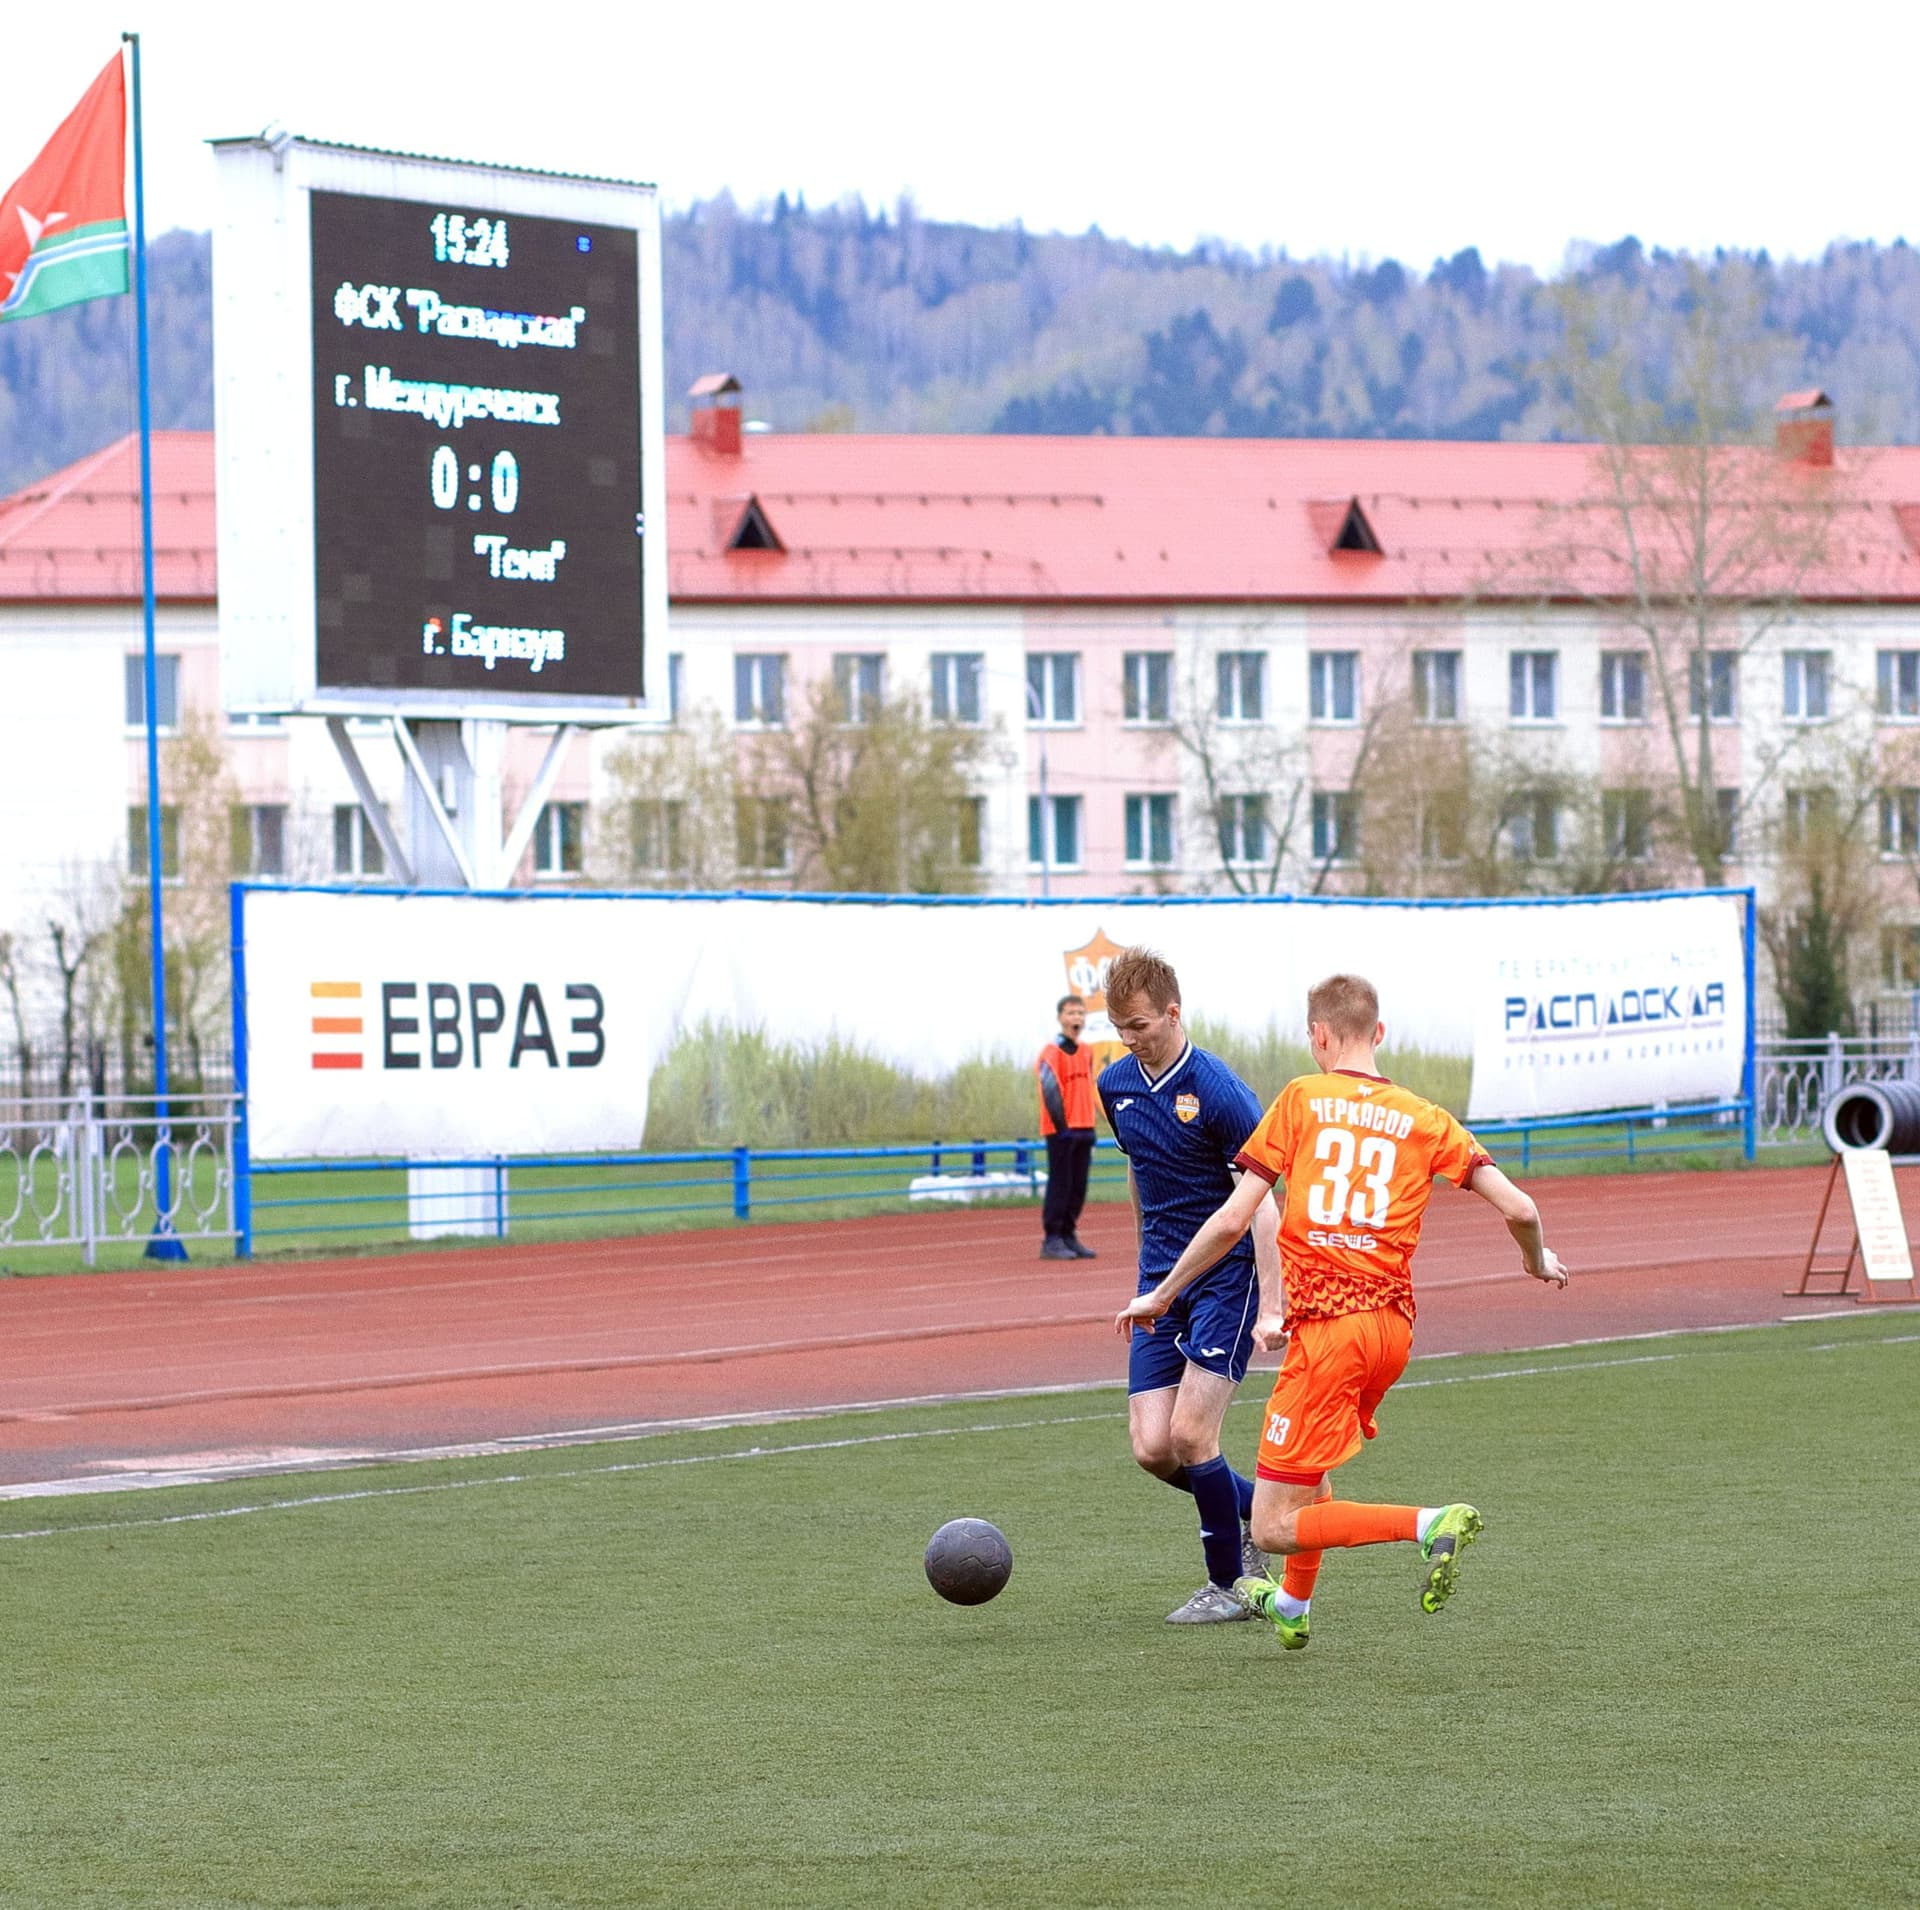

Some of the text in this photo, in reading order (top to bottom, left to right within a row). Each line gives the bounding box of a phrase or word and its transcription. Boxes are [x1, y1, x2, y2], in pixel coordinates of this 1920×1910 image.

[431, 214, 509, 268] 15:24
[335, 282, 404, 331] ФСК
[335, 374, 358, 407] г.
[382, 982, 606, 1069] ЕВРАЗ
[1309, 1097, 1415, 1140] ЧЕРКАСОВ
[1308, 1127, 1397, 1229] 33
[1266, 1413, 1291, 1446] 33
